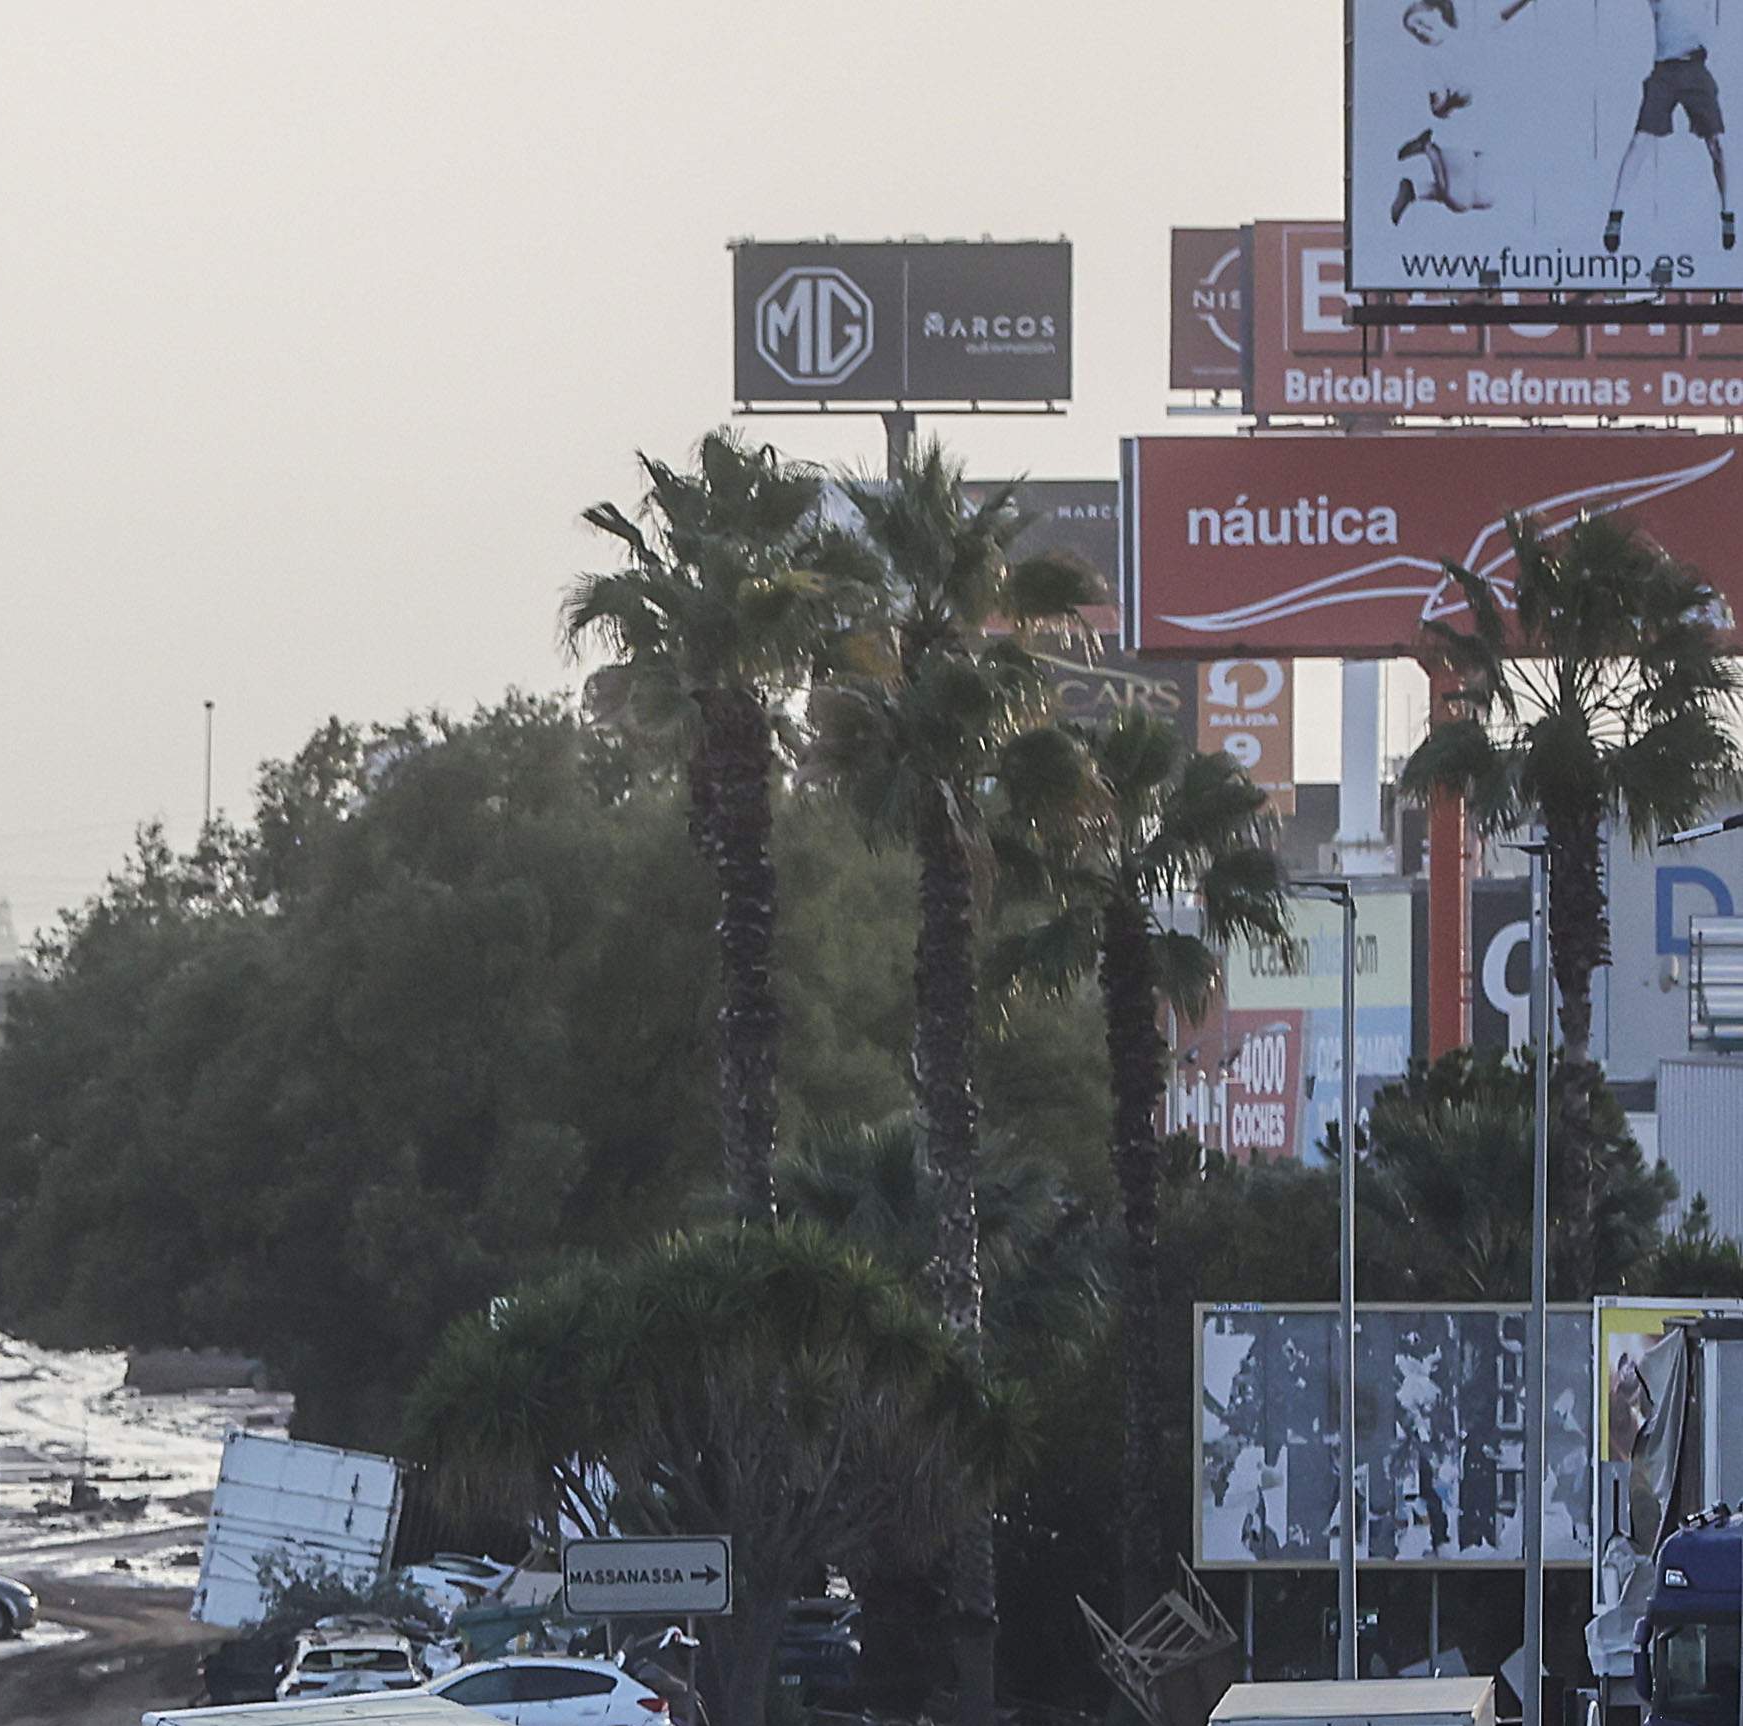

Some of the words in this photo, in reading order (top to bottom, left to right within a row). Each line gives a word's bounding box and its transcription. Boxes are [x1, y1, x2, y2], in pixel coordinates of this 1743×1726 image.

[1284, 367, 1437, 407] Bricolaje
[1466, 367, 1631, 407] Reformas
[1661, 367, 1743, 407] Deco
[1186, 496, 1400, 546] náutica
[1232, 1103, 1286, 1148] COCHES
[569, 1567, 685, 1587] MASSANASSA
